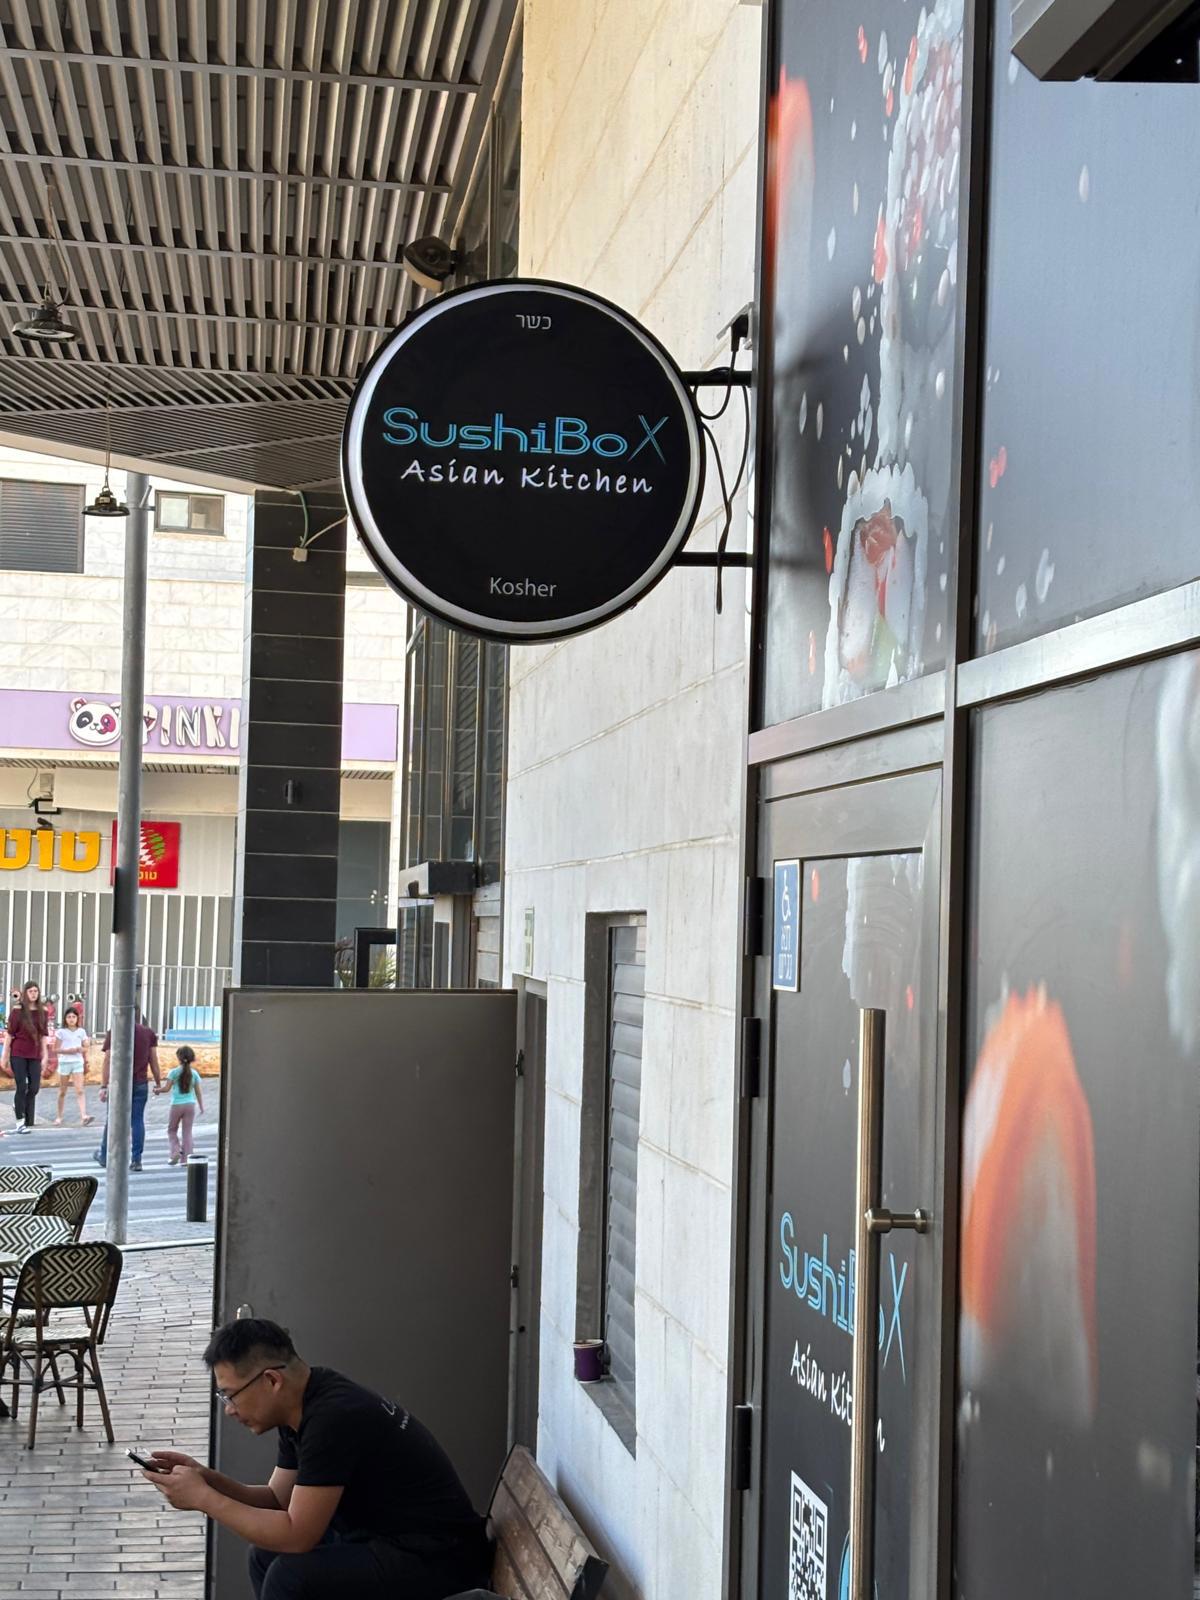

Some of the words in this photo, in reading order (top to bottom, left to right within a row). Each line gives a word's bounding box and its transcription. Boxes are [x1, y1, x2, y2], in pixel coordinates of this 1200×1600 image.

[515, 314, 552, 330] כשר
[400, 458, 504, 485] Asian
[520, 464, 653, 494] Kitchen
[489, 577, 557, 597] Kosher
[779, 1211, 908, 1385] SushiX
[790, 1339, 827, 1403] Asian
[830, 1371, 886, 1453] Kitn
